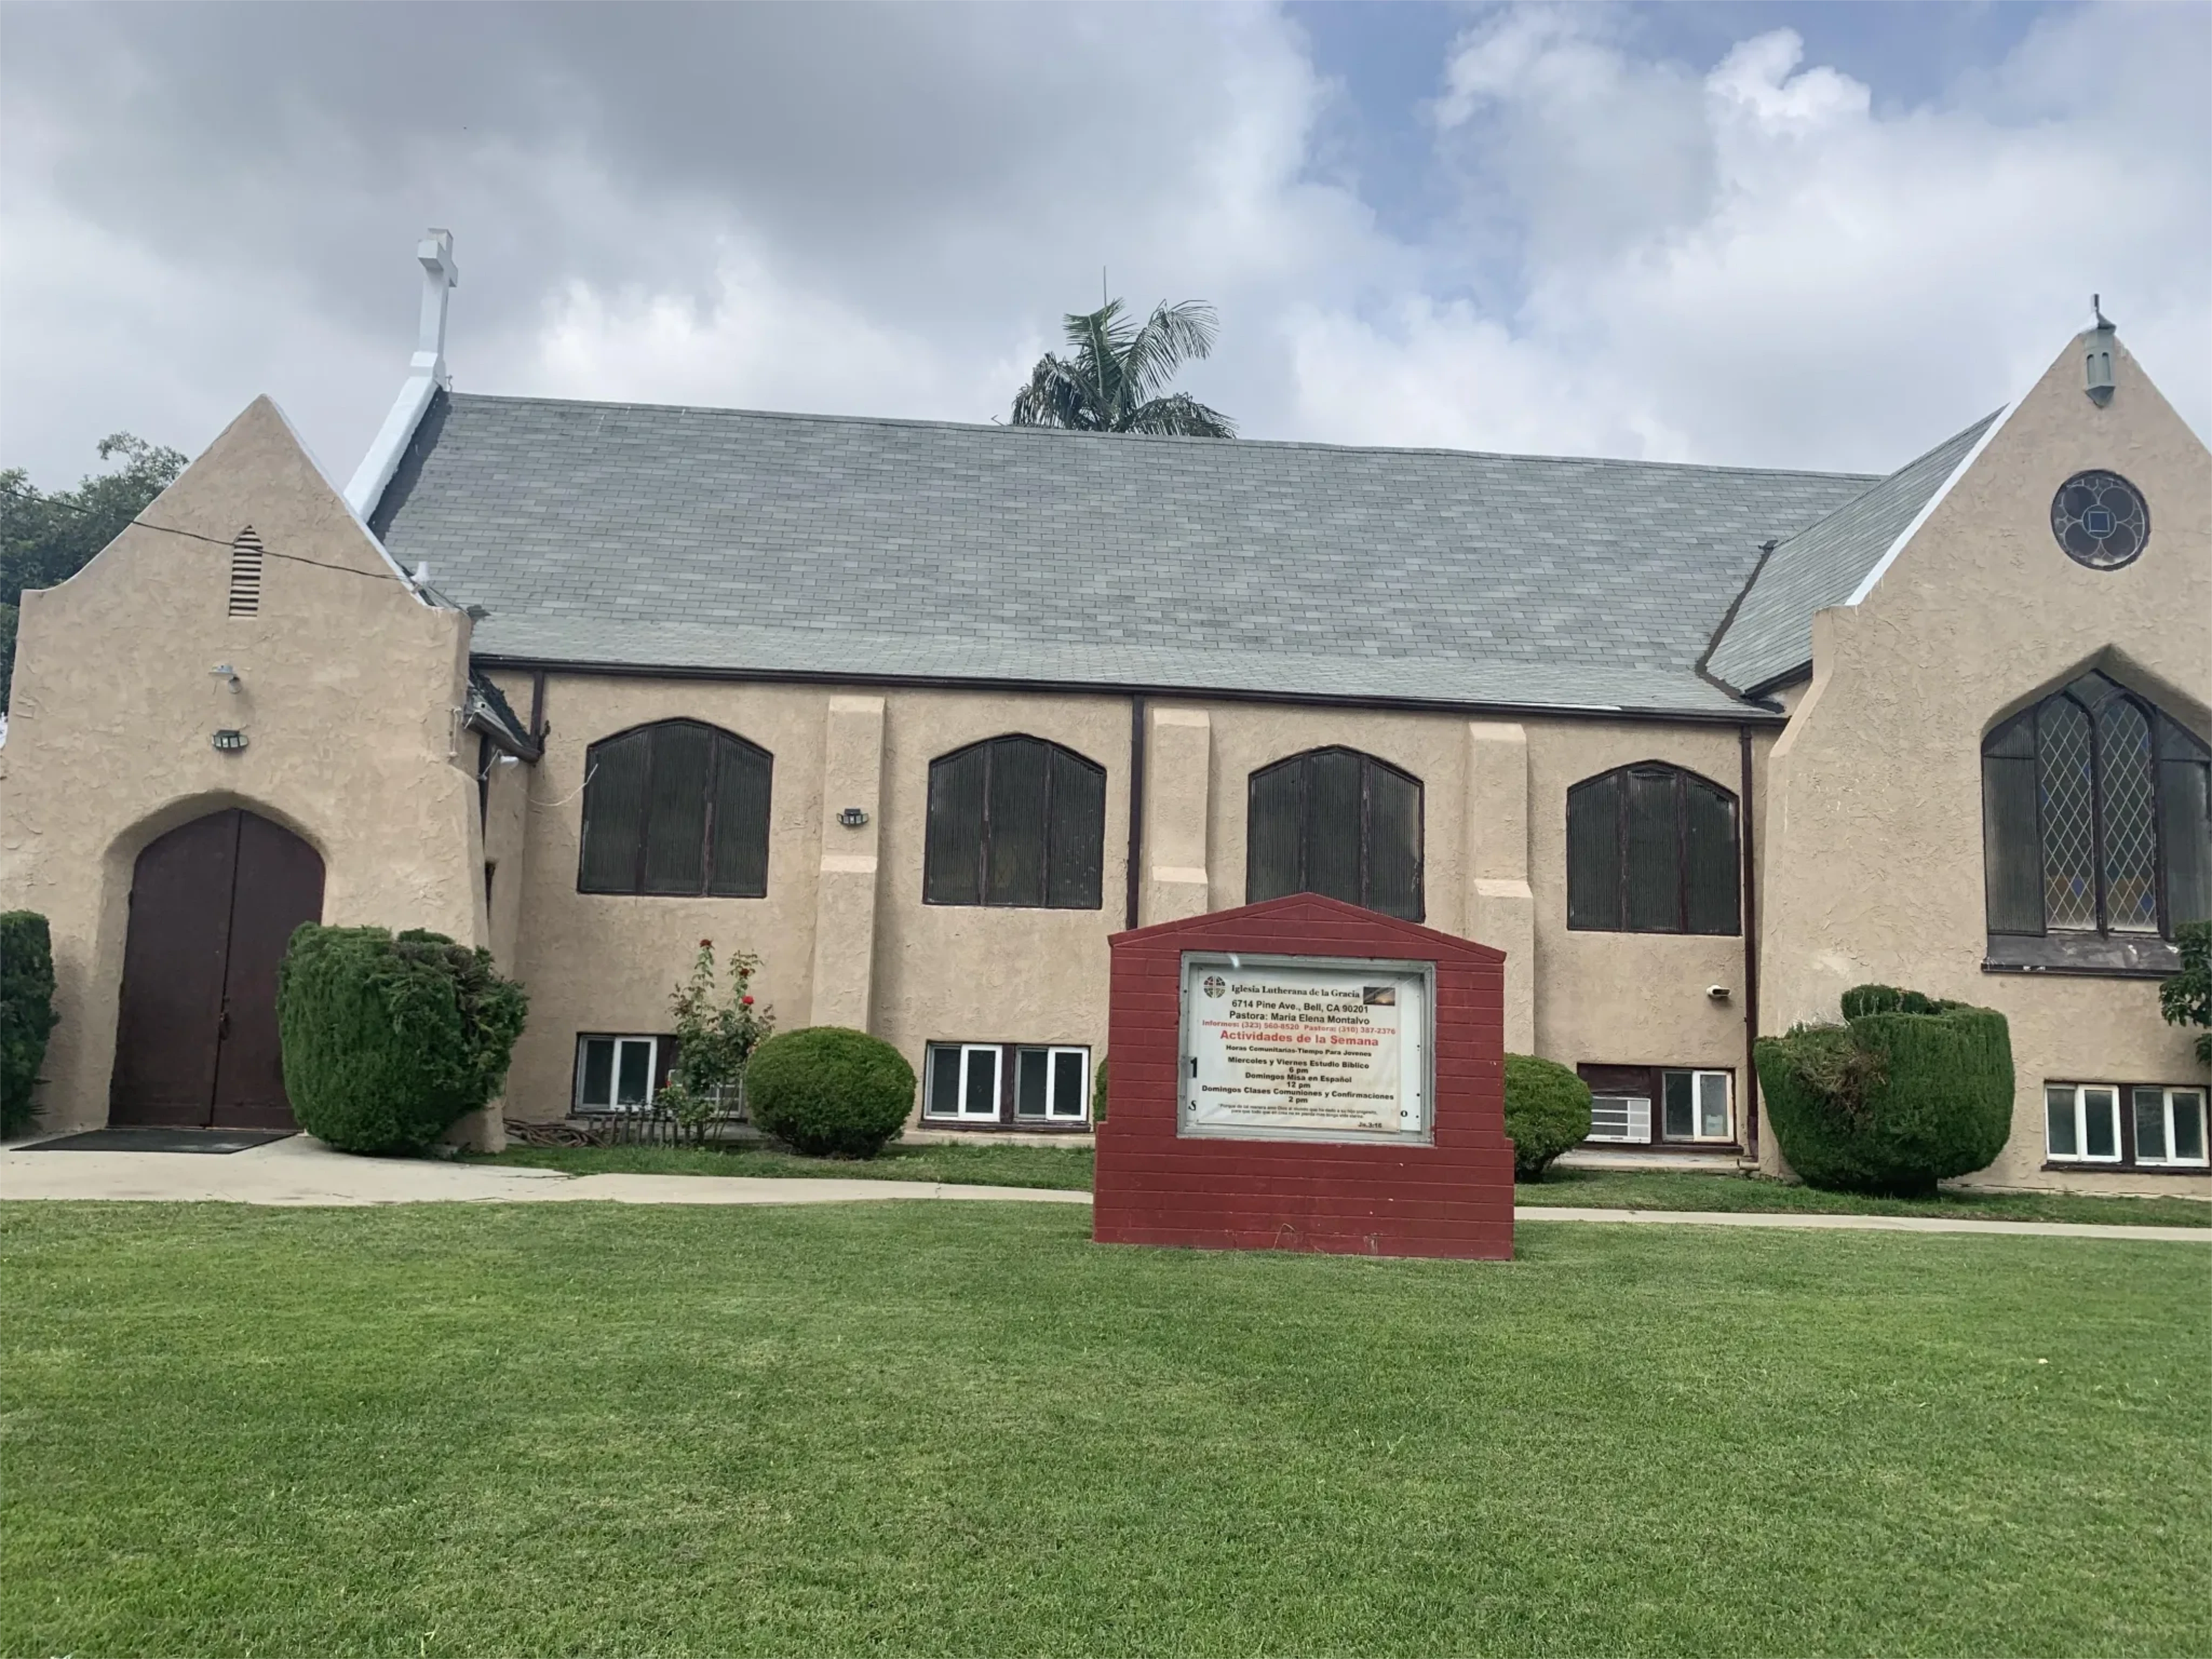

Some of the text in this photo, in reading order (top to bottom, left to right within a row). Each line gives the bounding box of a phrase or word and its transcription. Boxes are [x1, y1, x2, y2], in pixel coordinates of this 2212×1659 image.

[1231, 984, 1260, 994] Iglesia
[1262, 986, 1307, 995] Lutherana
[1331, 989, 1360, 998] Gracia
[1232, 1000, 1368, 1013] 6714 Pine Ave., Bell, CA 90201
[1230, 1010, 1370, 1024] Pastora: Maria Elena Montalvo
[1339, 1026, 1358, 1034] (310)
[1220, 1030, 1379, 1046] Actividades de la Semana
[1245, 1073, 1285, 1081] Domingos
[1320, 1075, 1352, 1083] Español
[1202, 1085, 1241, 1094] Domingos
[1273, 1088, 1323, 1096] Comuniones
[1332, 1091, 1394, 1100] Confirmaciones
